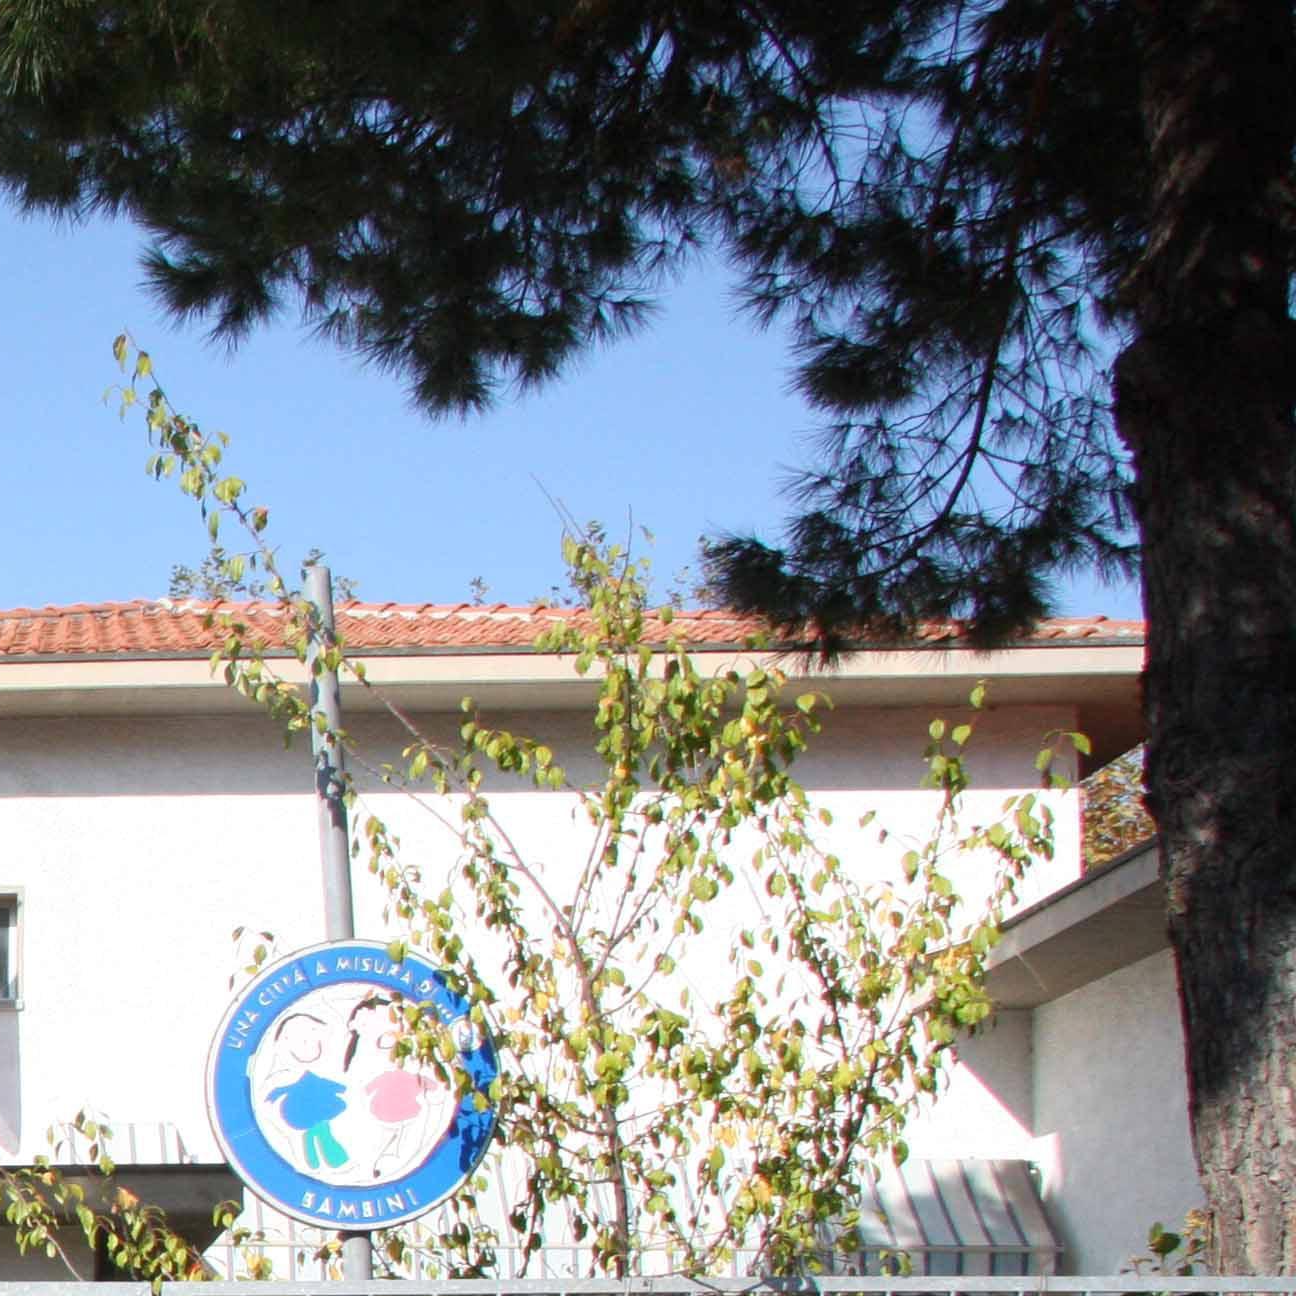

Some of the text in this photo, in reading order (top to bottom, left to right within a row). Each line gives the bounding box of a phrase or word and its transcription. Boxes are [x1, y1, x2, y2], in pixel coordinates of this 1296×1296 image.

[226, 1010, 260, 1050] UNA
[316, 959, 330, 977] A
[335, 956, 411, 985] MISURA
[300, 1187, 418, 1220] BAMBINI
